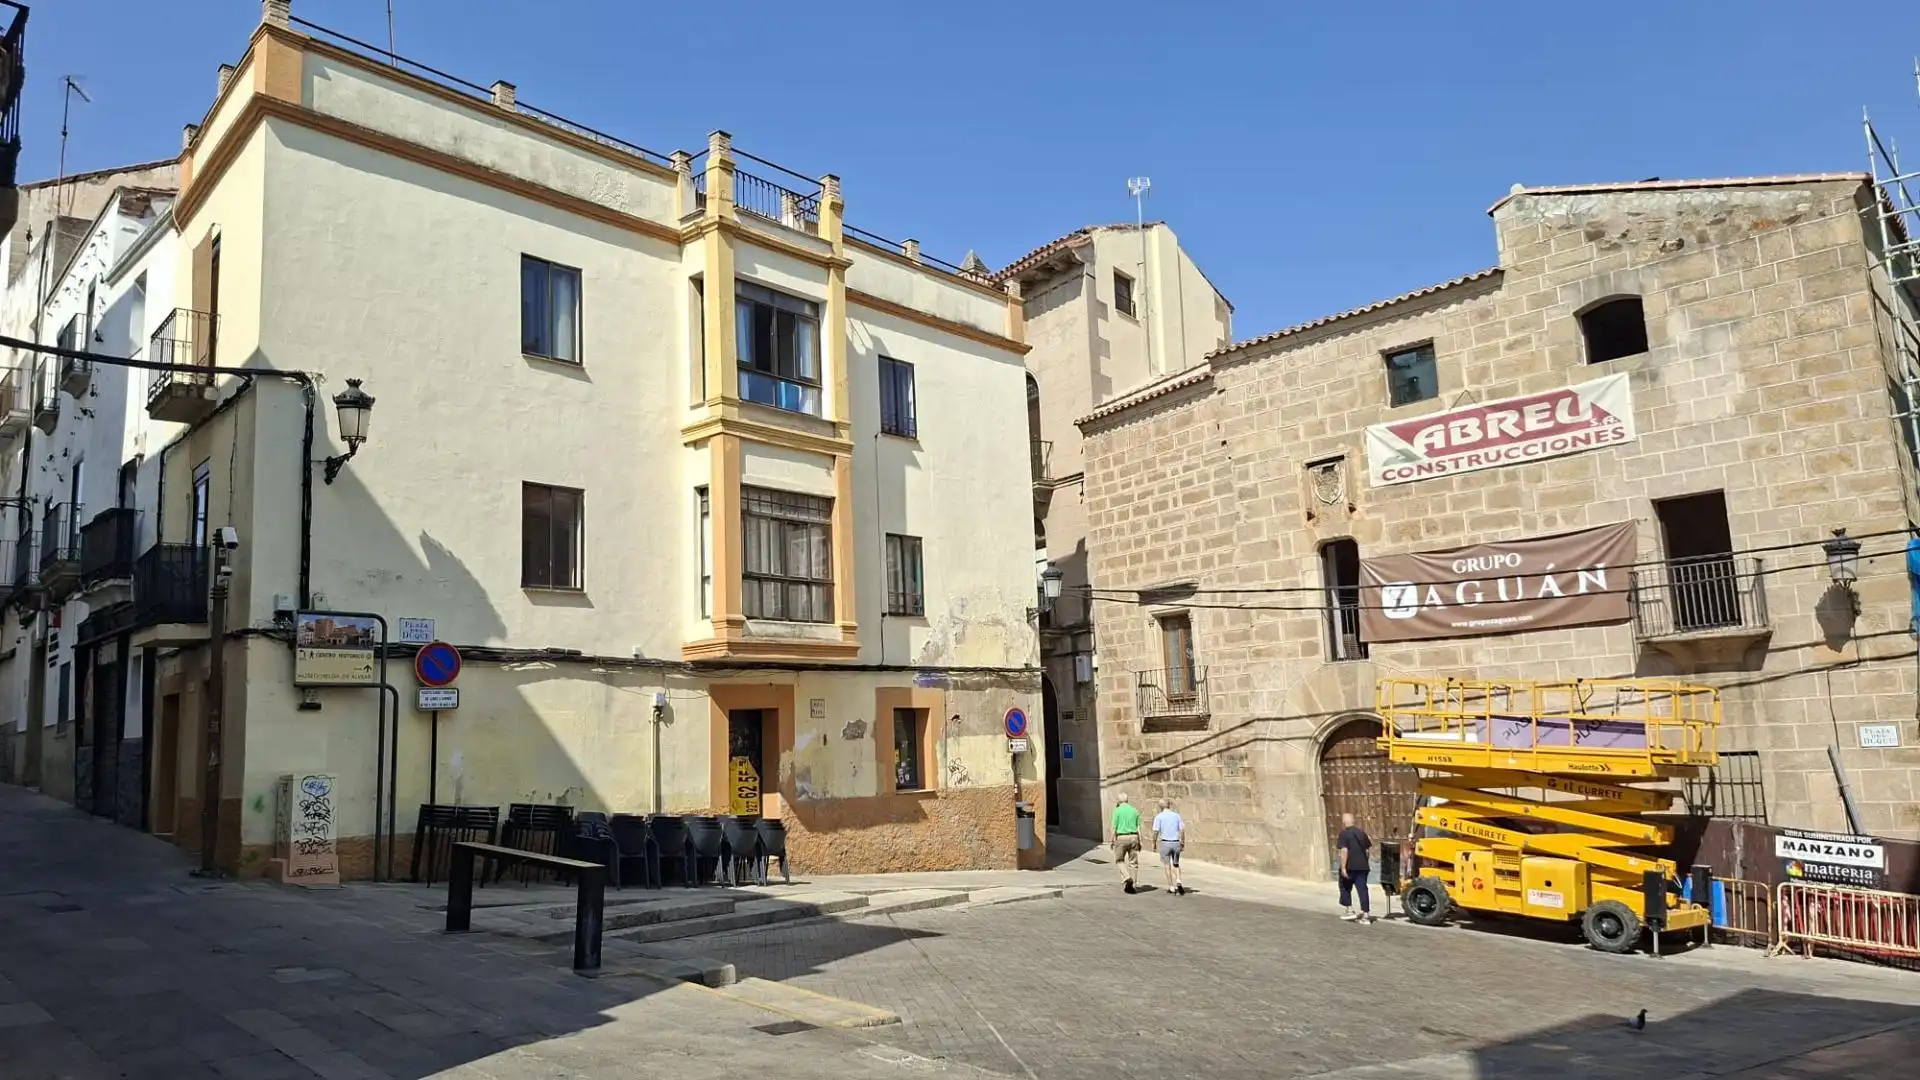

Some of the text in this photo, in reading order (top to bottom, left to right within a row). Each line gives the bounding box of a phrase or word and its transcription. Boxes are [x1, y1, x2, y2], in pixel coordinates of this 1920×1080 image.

[1413, 395, 1592, 452] ABREU
[1381, 426, 1625, 482] CONSTRUCCIONES
[1452, 552, 1522, 574] GRUPO
[1382, 563, 1608, 617] ZAGUÁN
[1783, 840, 1875, 858] MANZANO
[1784, 829, 1802, 838] OBRA
[1857, 836, 1872, 845] POR
